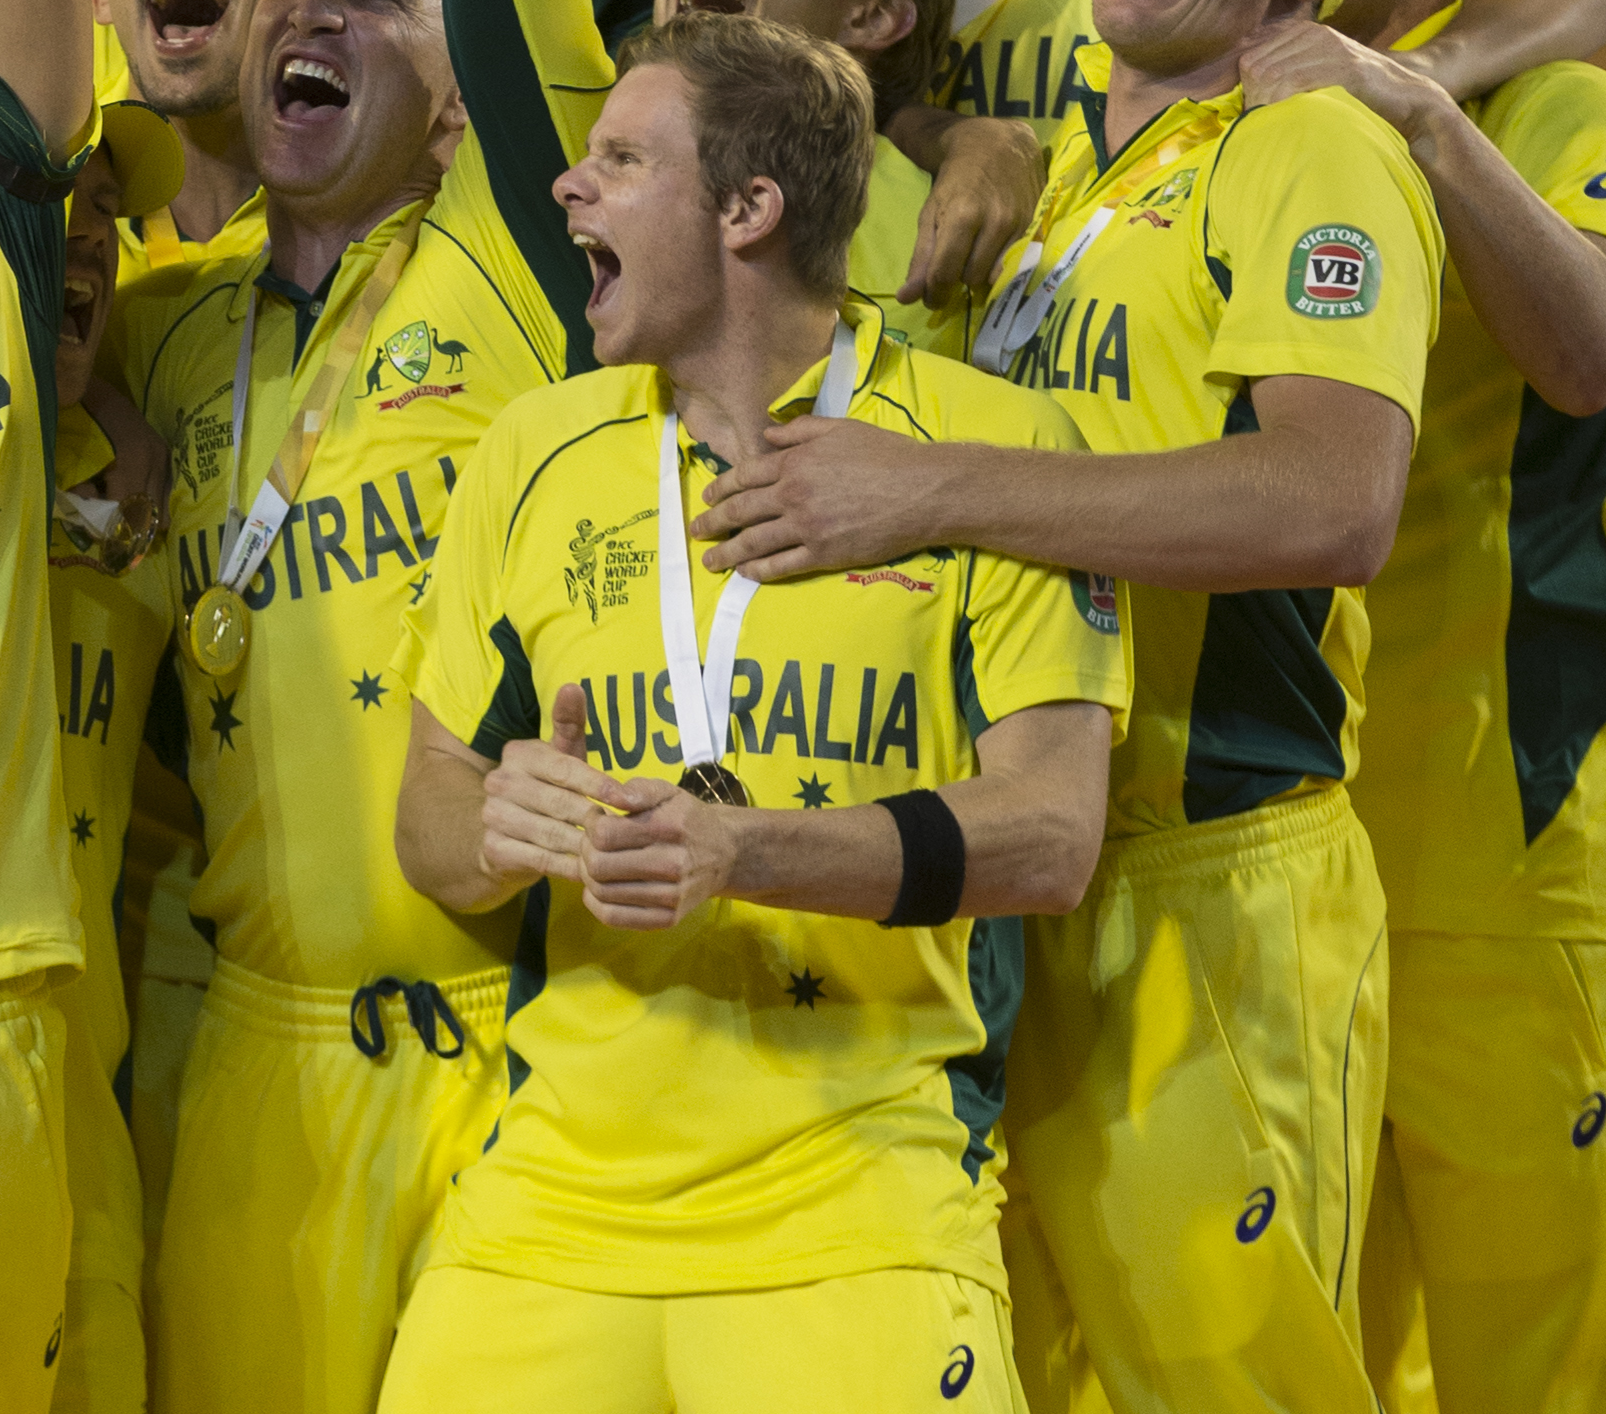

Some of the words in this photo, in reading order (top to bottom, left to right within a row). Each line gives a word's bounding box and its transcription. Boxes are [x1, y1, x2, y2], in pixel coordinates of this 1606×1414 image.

[1297, 228, 1377, 261] VICTORIA
[1310, 258, 1360, 286] VB
[1295, 295, 1365, 316] BITTER
[195, 421, 234, 443] CRICKE
[197, 451, 217, 470] CUP
[198, 465, 221, 484] 2015
[605, 550, 658, 566] CRICKET
[604, 565, 648, 579] WORLD
[602, 580, 627, 593] CUP
[601, 593, 629, 607] 2015
[578, 657, 919, 772] AUSRALIA
